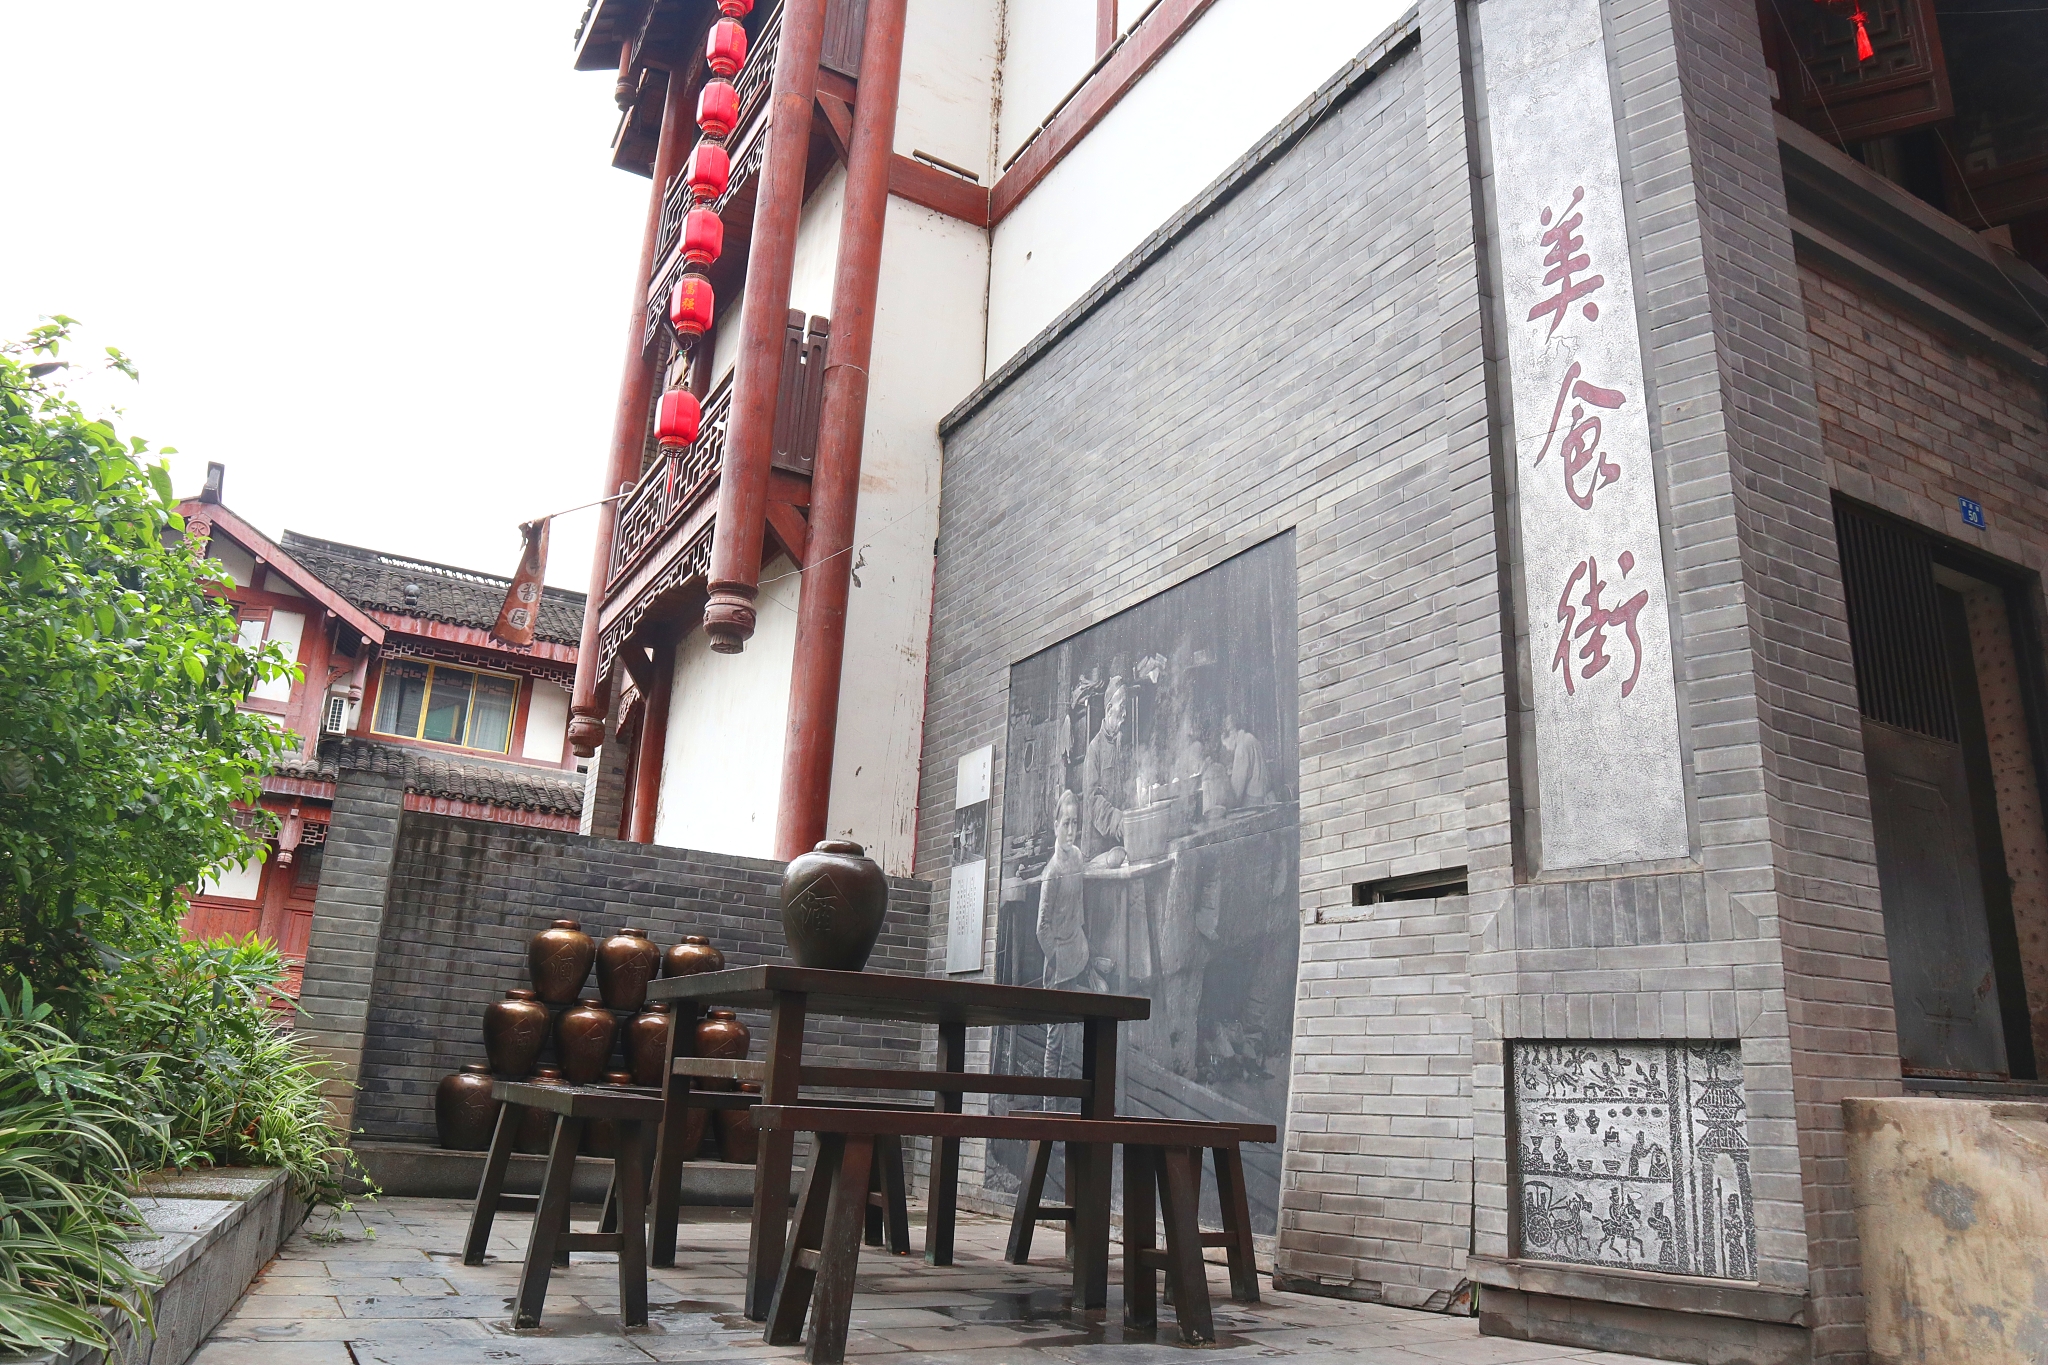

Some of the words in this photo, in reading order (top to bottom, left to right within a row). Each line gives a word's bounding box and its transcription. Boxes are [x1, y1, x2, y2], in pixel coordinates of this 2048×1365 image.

[681, 281, 698, 311] 富强
[1526, 185, 1649, 699] 美食街
[1968, 510, 1978, 523] 50
